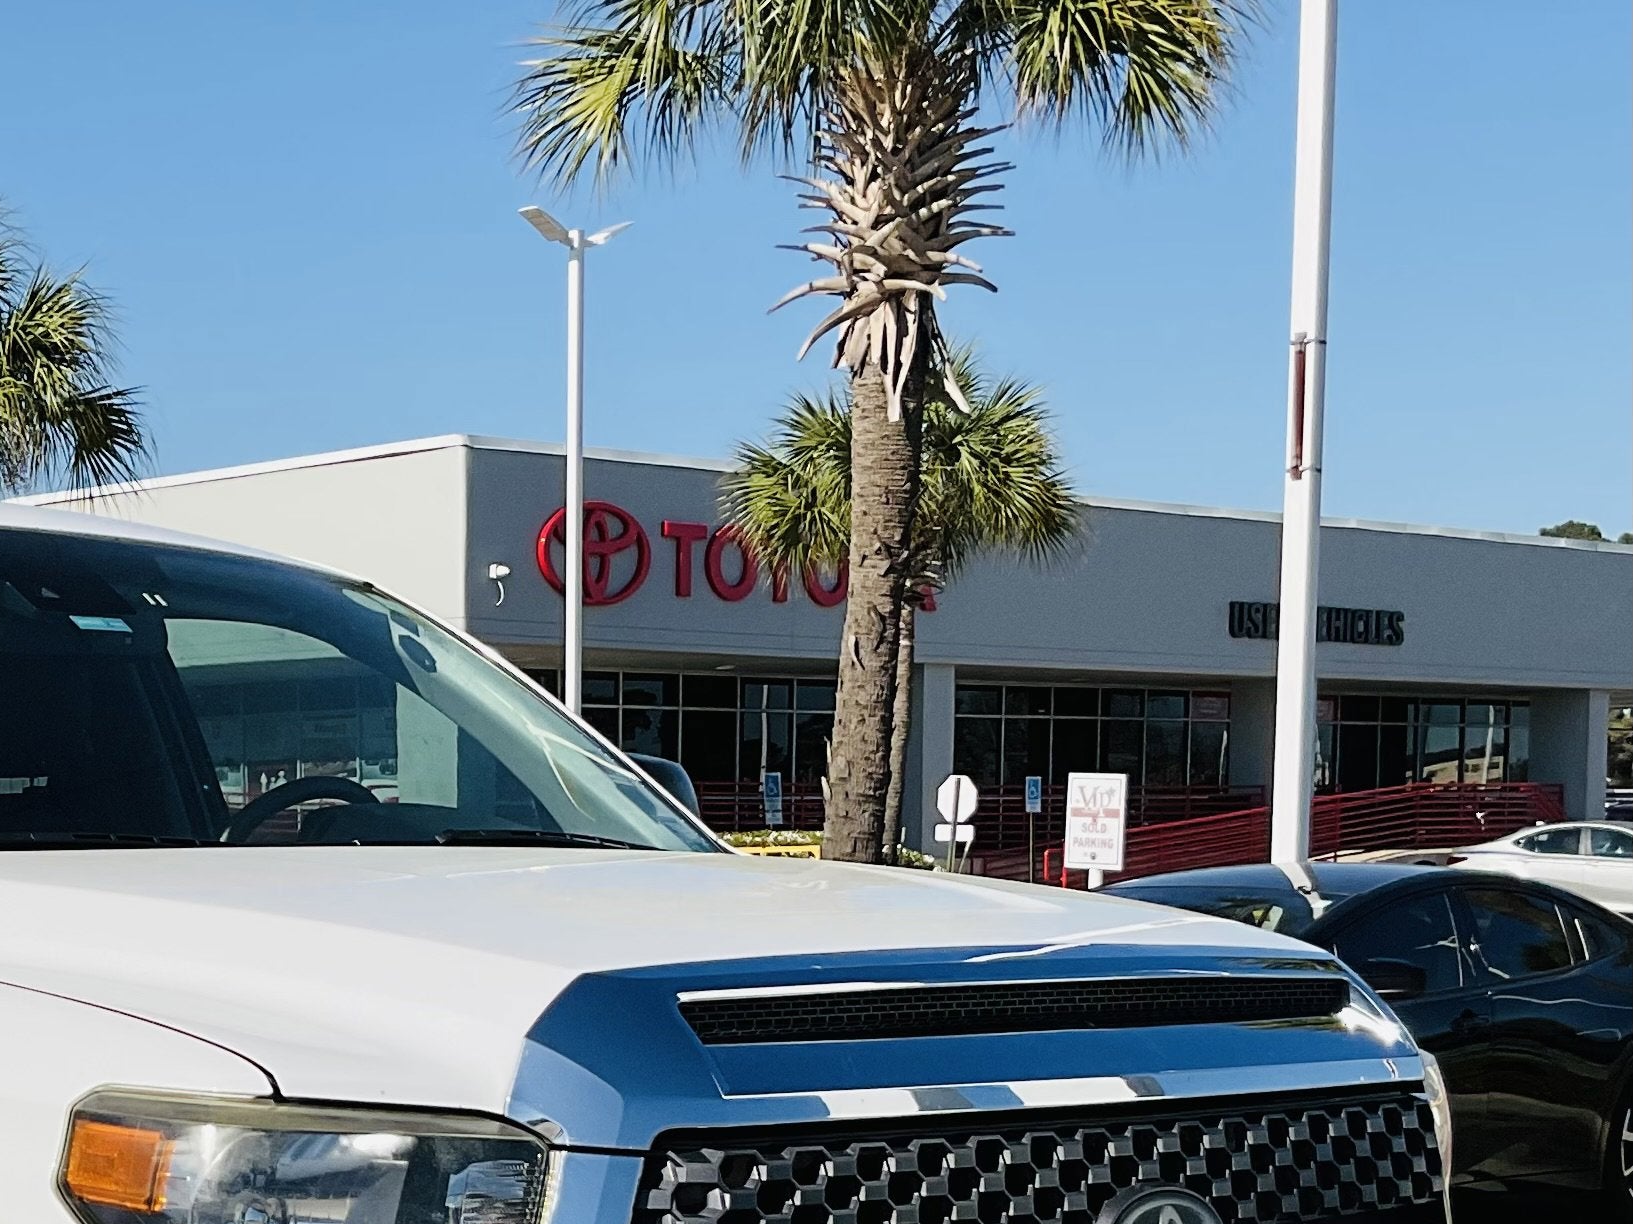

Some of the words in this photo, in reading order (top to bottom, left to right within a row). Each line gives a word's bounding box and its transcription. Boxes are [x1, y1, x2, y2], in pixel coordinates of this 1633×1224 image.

[661, 520, 937, 612] TOO
[1229, 601, 1280, 640] USE
[1316, 606, 1405, 646] EHICLES
[1081, 823, 1107, 834] SOLD
[1072, 837, 1114, 850] PARKING
